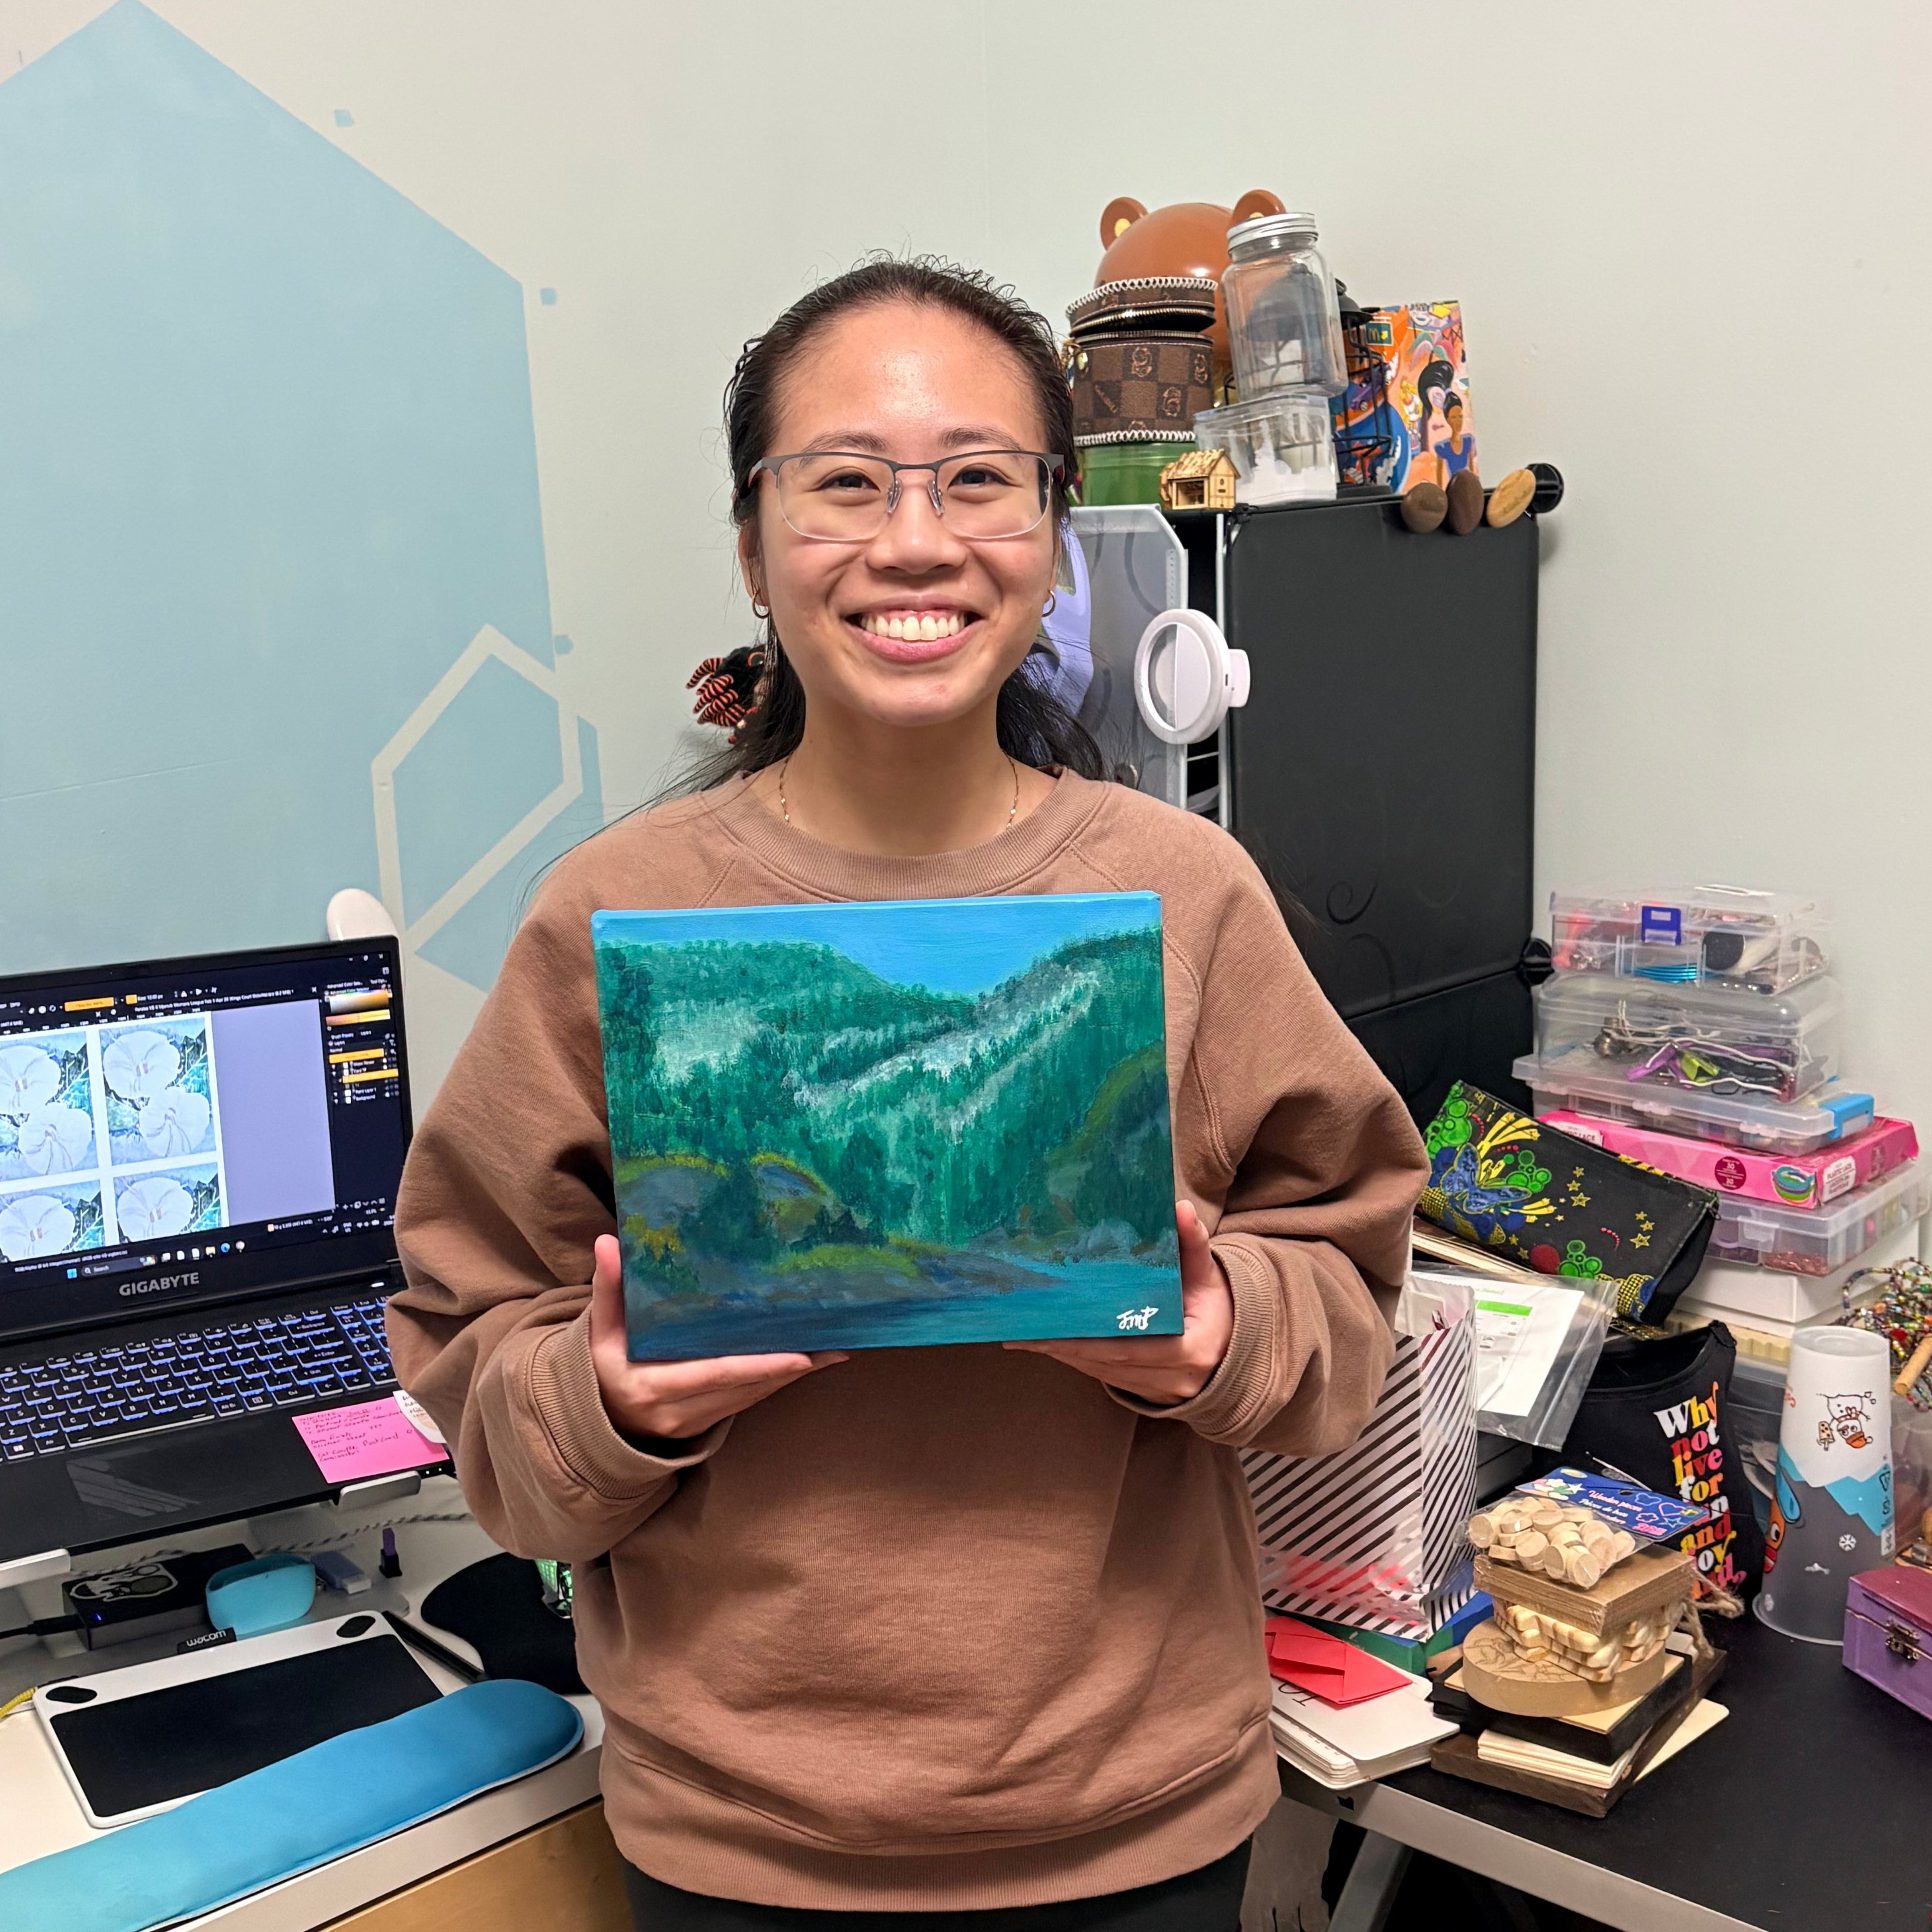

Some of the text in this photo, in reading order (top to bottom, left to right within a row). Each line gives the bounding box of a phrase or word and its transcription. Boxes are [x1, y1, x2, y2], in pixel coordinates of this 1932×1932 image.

[119, 1272, 200, 1297] GIGABYTE
[1653, 1381, 1719, 1438] Why
[1671, 1420, 1720, 1454] not
[1672, 1448, 1723, 1486] live
[1588, 1490, 1620, 1505] Wooden
[1679, 1473, 1723, 1502] for
[1680, 1509, 1731, 1555] and
[1688, 1530, 1737, 1573] oy
[186, 1631, 226, 1647] wacom
